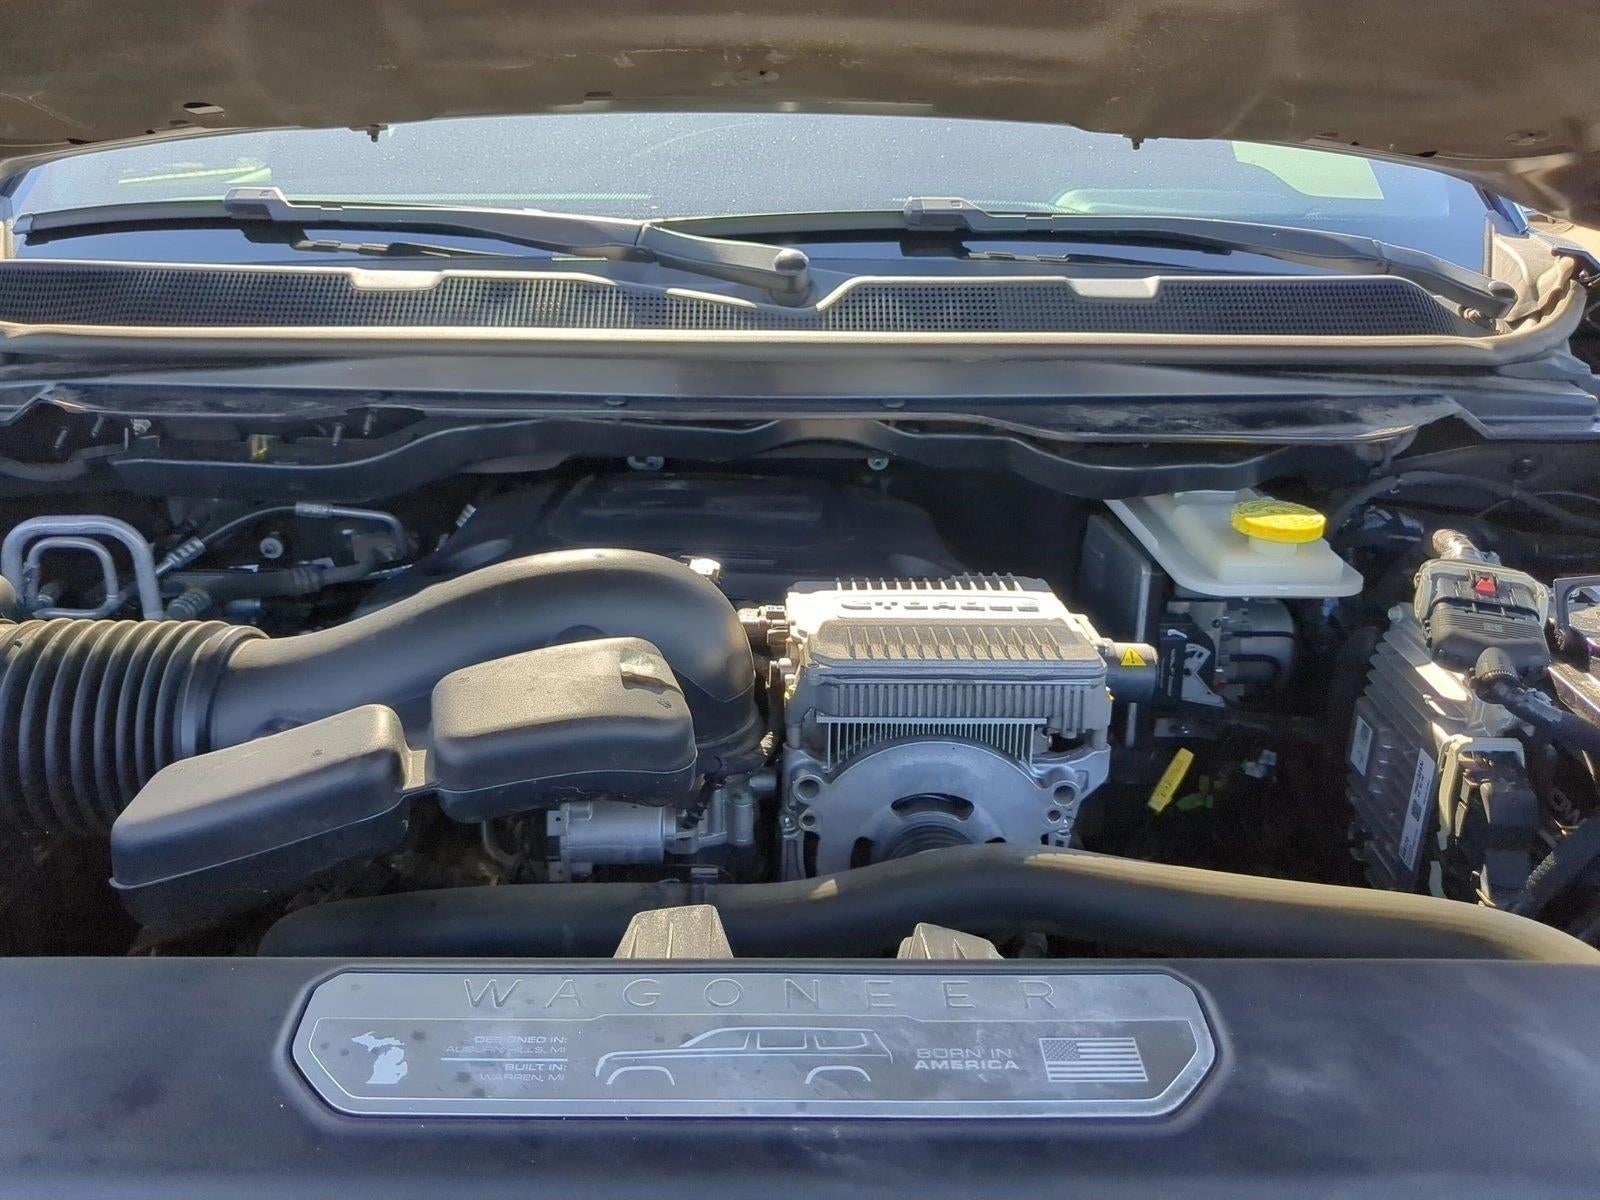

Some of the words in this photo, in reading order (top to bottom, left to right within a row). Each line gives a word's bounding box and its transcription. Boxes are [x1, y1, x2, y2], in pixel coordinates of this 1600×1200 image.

[463, 977, 1057, 1009] WAGONEER
[474, 1035, 547, 1044] DESIGNED
[550, 1035, 568, 1044] IN:
[550, 1045, 566, 1054] MI
[916, 1048, 982, 1058] BORN
[990, 1048, 1013, 1059] IN
[504, 1063, 545, 1071] BUILT
[548, 1063, 568, 1072] IN:
[914, 1059, 1020, 1070] AMERICA
[547, 1073, 565, 1081] MI
